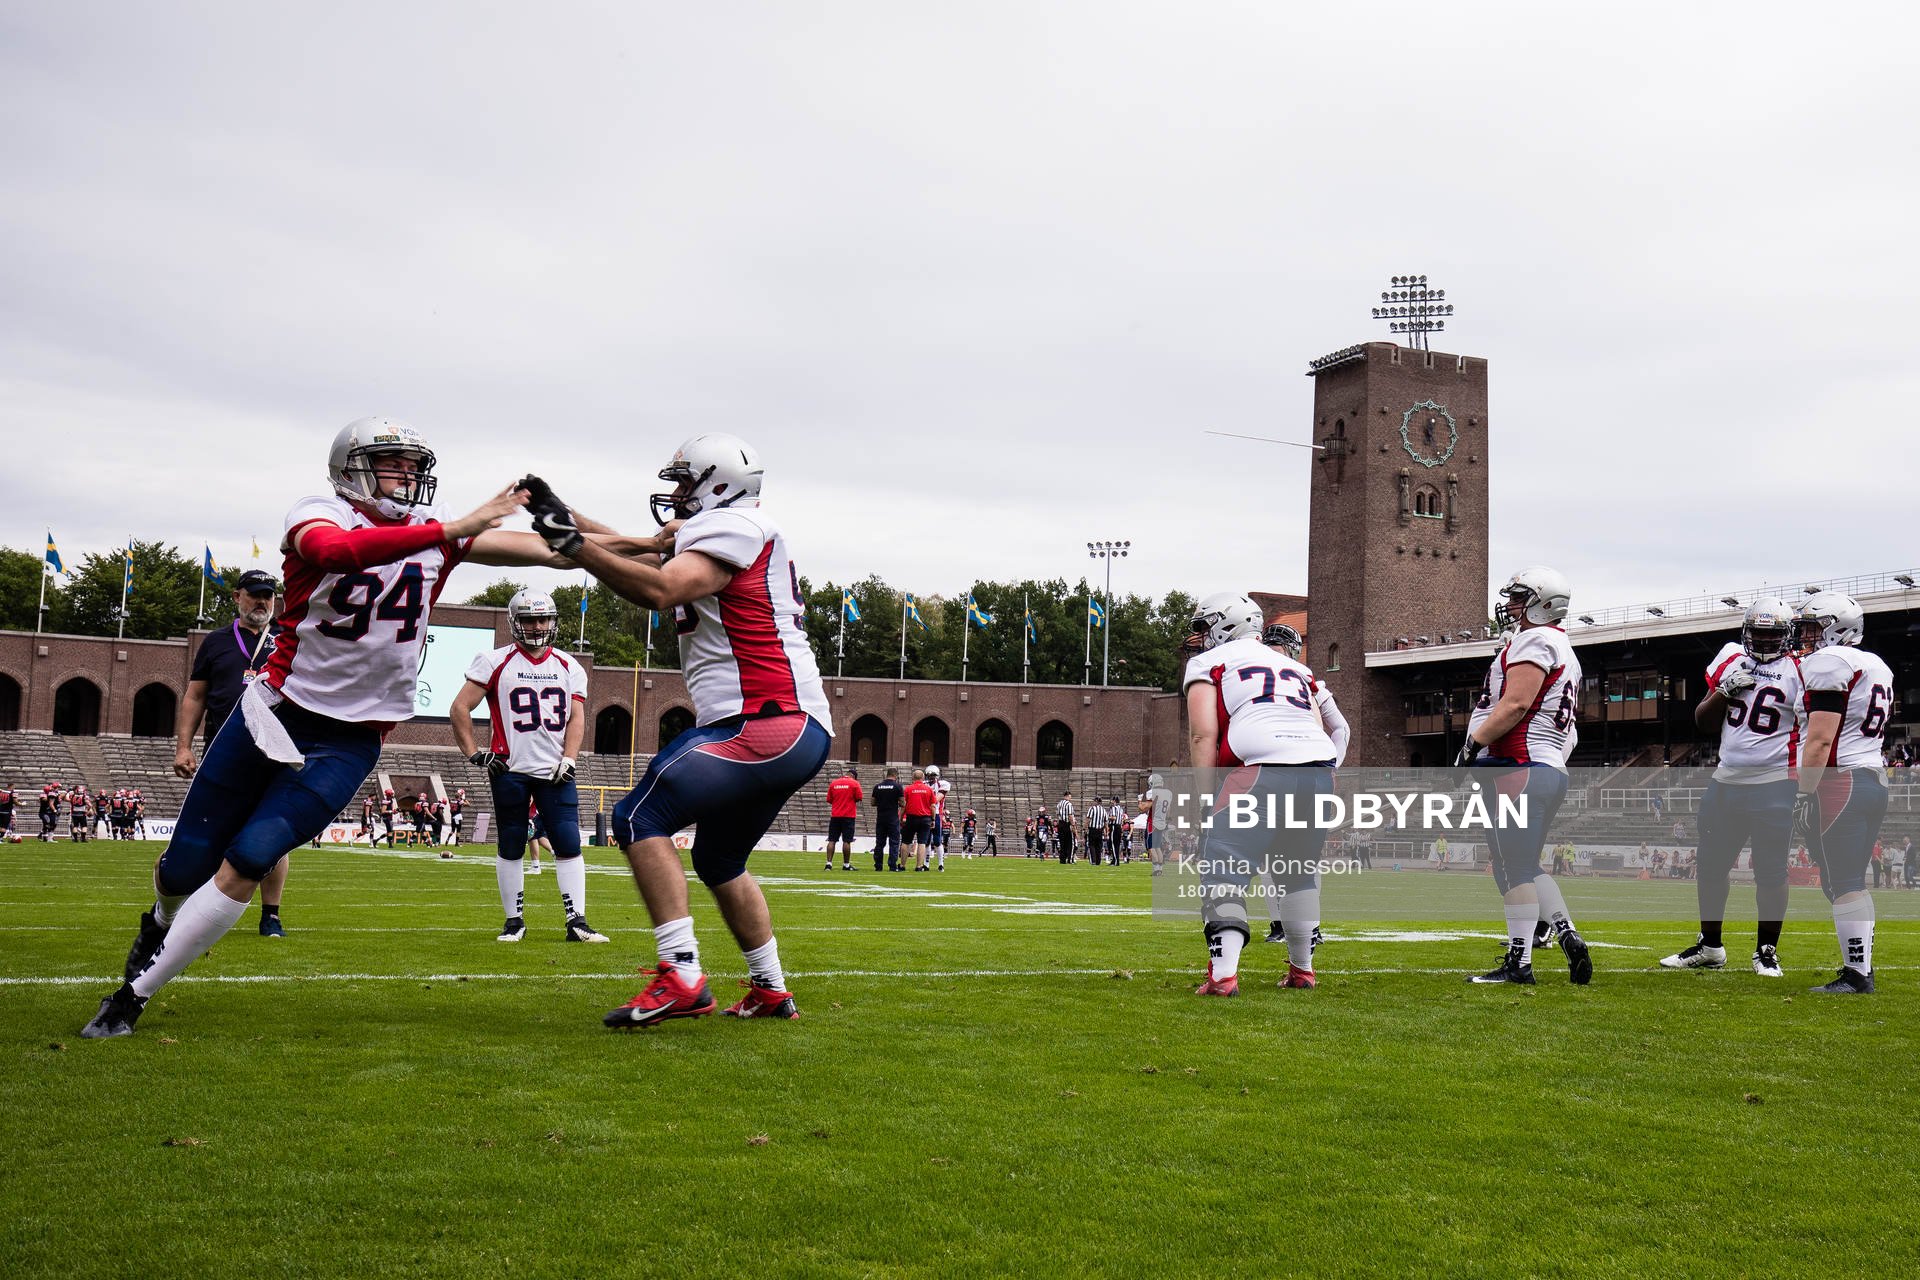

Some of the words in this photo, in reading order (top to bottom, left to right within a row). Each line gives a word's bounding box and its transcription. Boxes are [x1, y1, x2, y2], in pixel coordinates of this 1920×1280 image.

[315, 562, 424, 643] 94
[509, 687, 566, 733] 93
[1238, 665, 1312, 711] 73
[1847, 937, 1865, 962] SMM
